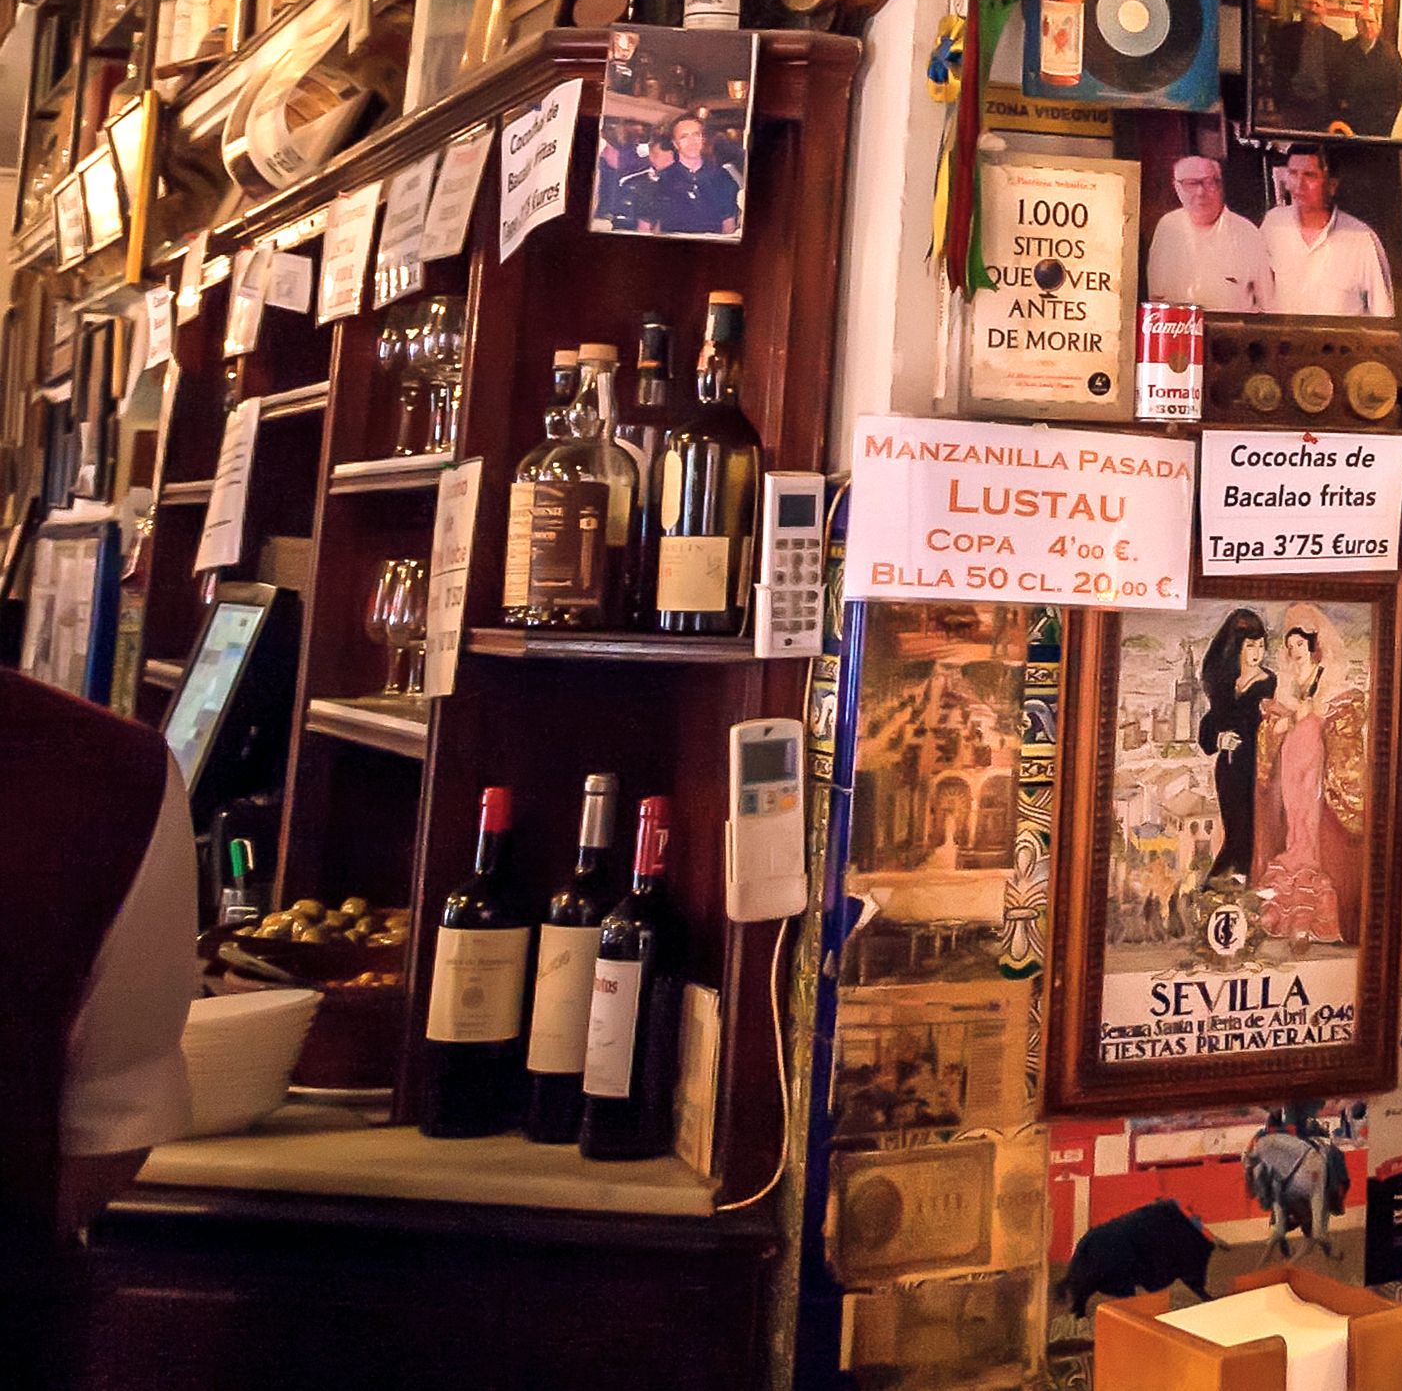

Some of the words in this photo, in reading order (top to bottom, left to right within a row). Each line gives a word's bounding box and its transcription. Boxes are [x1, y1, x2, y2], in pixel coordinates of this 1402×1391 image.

[1017, 198, 1089, 229] 1.000
[1013, 236, 1085, 259] SITIOS
[986, 264, 1033, 288] QUE
[1065, 269, 1111, 292] VER
[1008, 299, 1087, 321] ANTES
[987, 328, 1017, 350] DE
[1025, 330, 1103, 353] MORIR
[864, 434, 1070, 471] MANZANILLA
[1078, 449, 1192, 481] PASADA
[1230, 444, 1337, 469] Cocochas
[1344, 446, 1375, 468] de
[948, 478, 1127, 523] LUSTAU
[1223, 484, 1312, 509] Bacalao
[1319, 484, 1377, 507] fritas
[926, 528, 1016, 555] COPA
[1208, 535, 1265, 564] Tapa
[1273, 534, 1324, 557] 3'75
[871, 562, 956, 588] BLLA
[966, 566, 1009, 590] 50
[1017, 572, 1063, 593] CL.
[1149, 974, 1311, 1018] SEVILLA
[1153, 1018, 1193, 1037] Santa
[1244, 1012, 1265, 1028] de
[1268, 1007, 1307, 1027] Abril
[1101, 1036, 1189, 1063] FIESTAS
[1196, 1023, 1353, 1055] PRIMAVERALES
